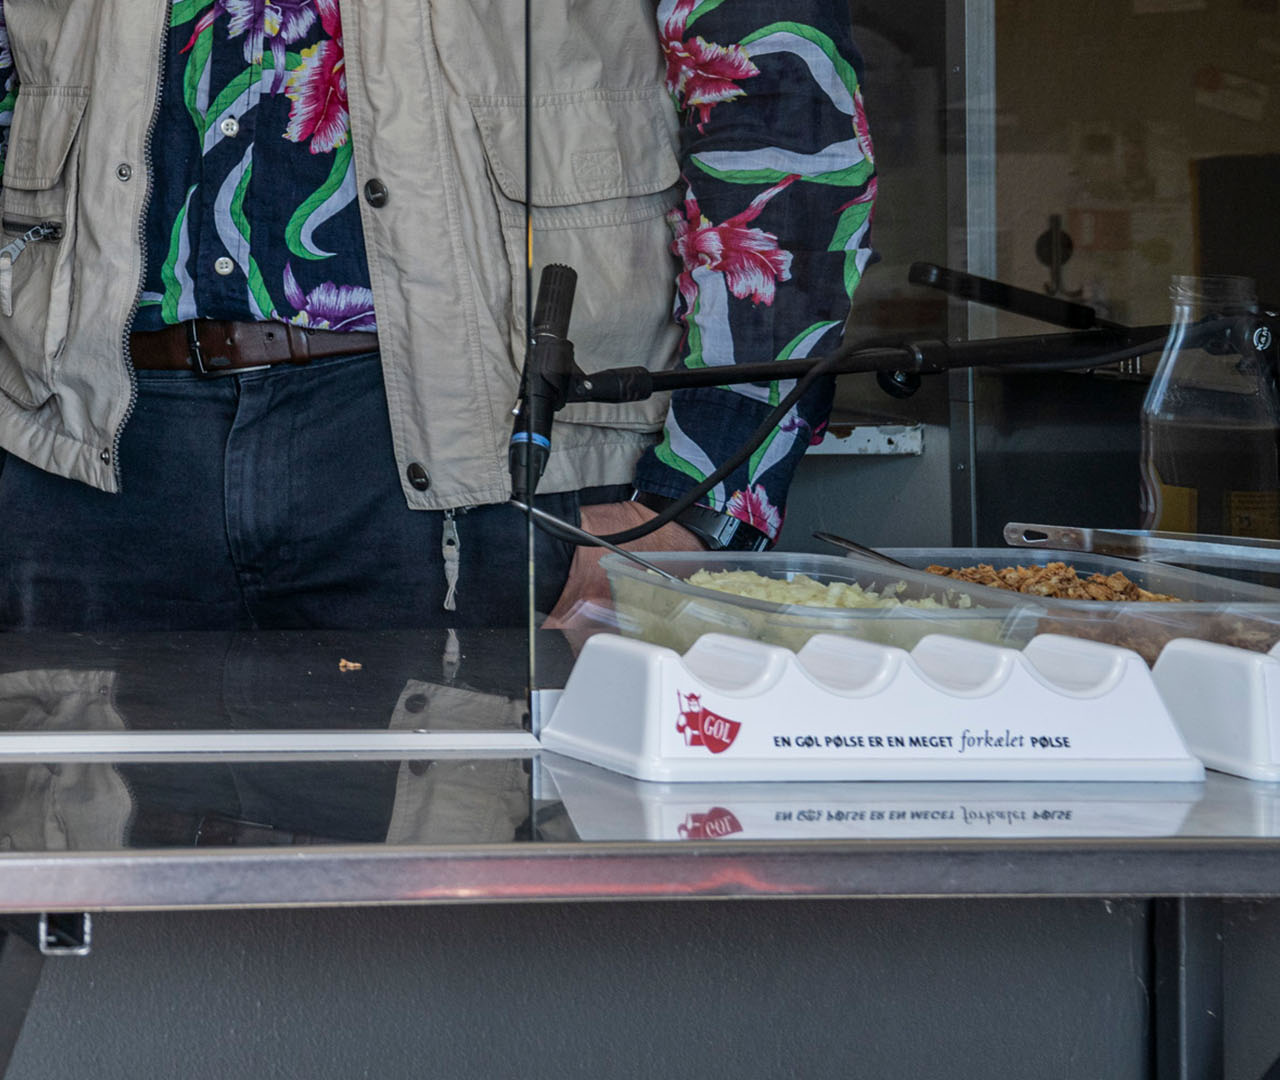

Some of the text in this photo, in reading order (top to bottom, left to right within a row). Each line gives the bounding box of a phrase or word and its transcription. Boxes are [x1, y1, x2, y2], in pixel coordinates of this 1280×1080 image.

[703, 715, 731, 744] GØL
[773, 729, 1071, 753] EN GØL PØLSE ER EN MEGET forkælet PØLSE
